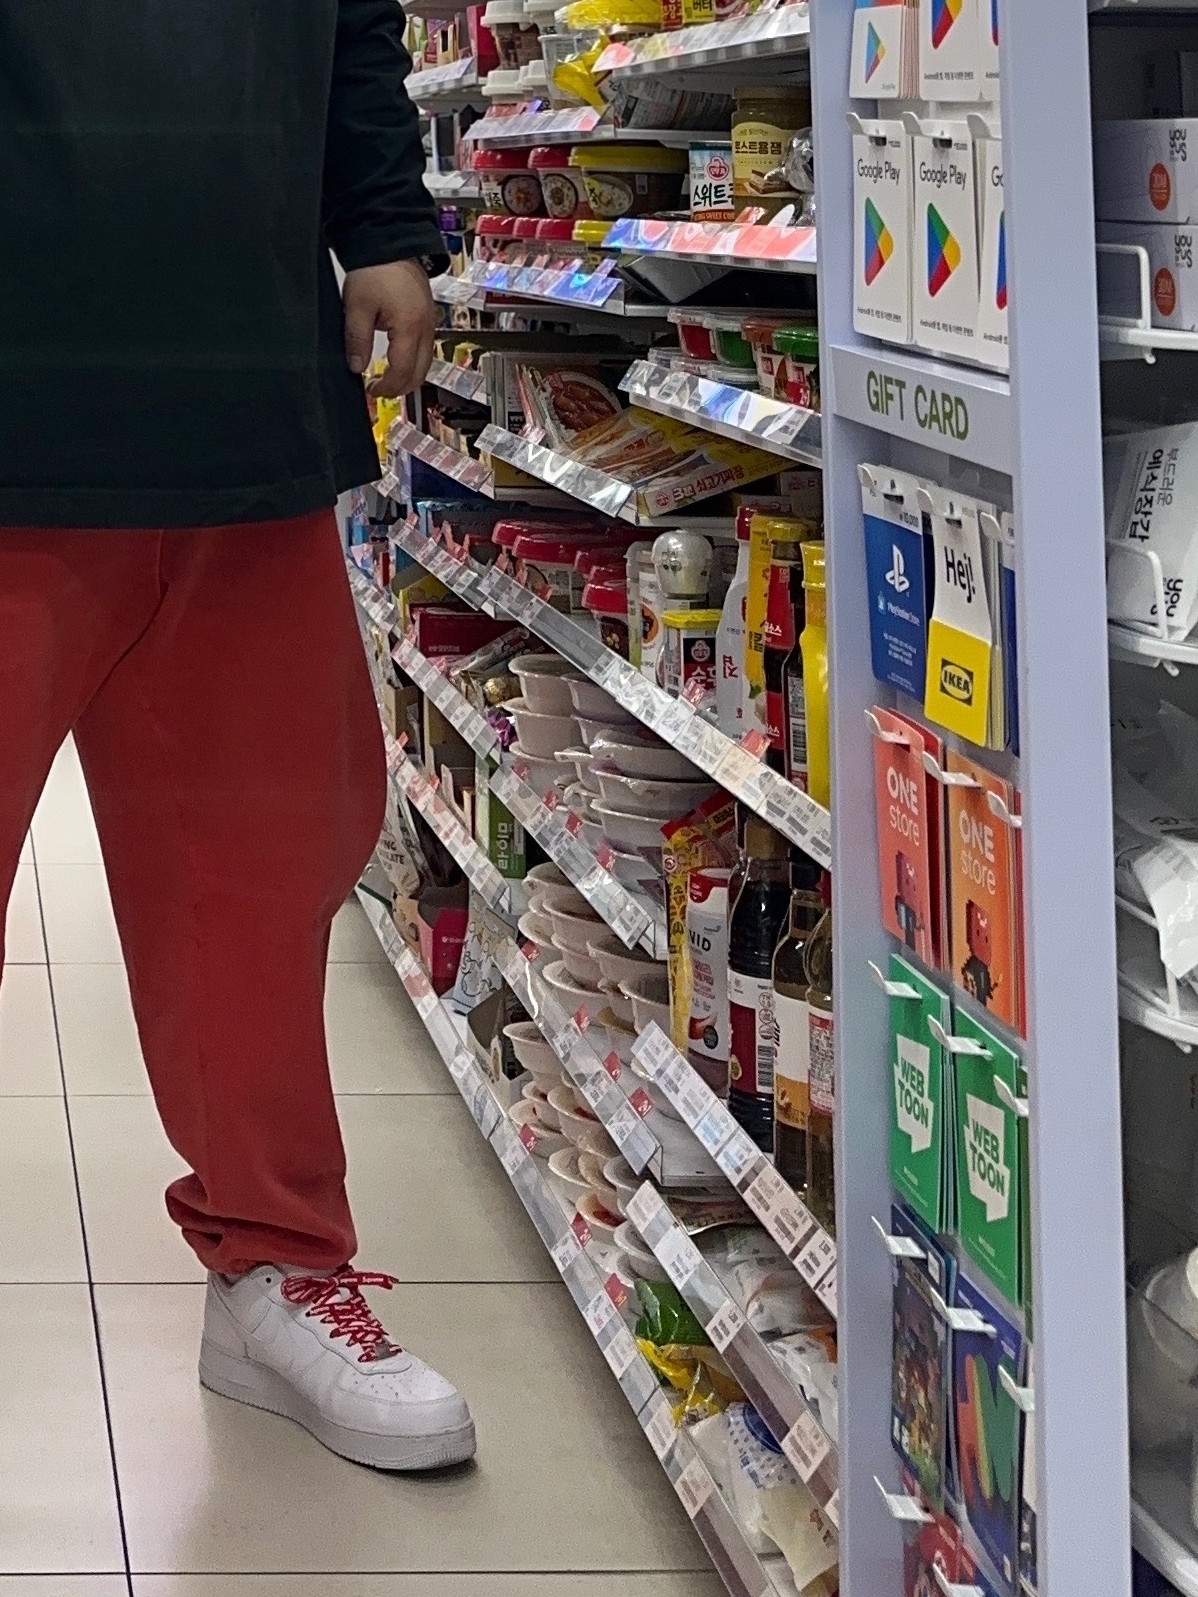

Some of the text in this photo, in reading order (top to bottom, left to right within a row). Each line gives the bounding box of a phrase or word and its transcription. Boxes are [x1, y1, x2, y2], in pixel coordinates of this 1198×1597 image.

[857, 159, 900, 185] Google Play
[919, 162, 967, 190] Google Play
[866, 370, 969, 441] GIFT CARD
[944, 546, 976, 604] Hej!
[943, 670, 971, 696] IKEA
[885, 764, 919, 819] ONE
[889, 805, 920, 847] store
[959, 809, 996, 862] ONE
[961, 846, 996, 896] store
[900, 1055, 926, 1097] WEB
[897, 1085, 929, 1130] TOON
[971, 1124, 1000, 1165] WEB
[968, 1150, 1008, 1198] TOON
